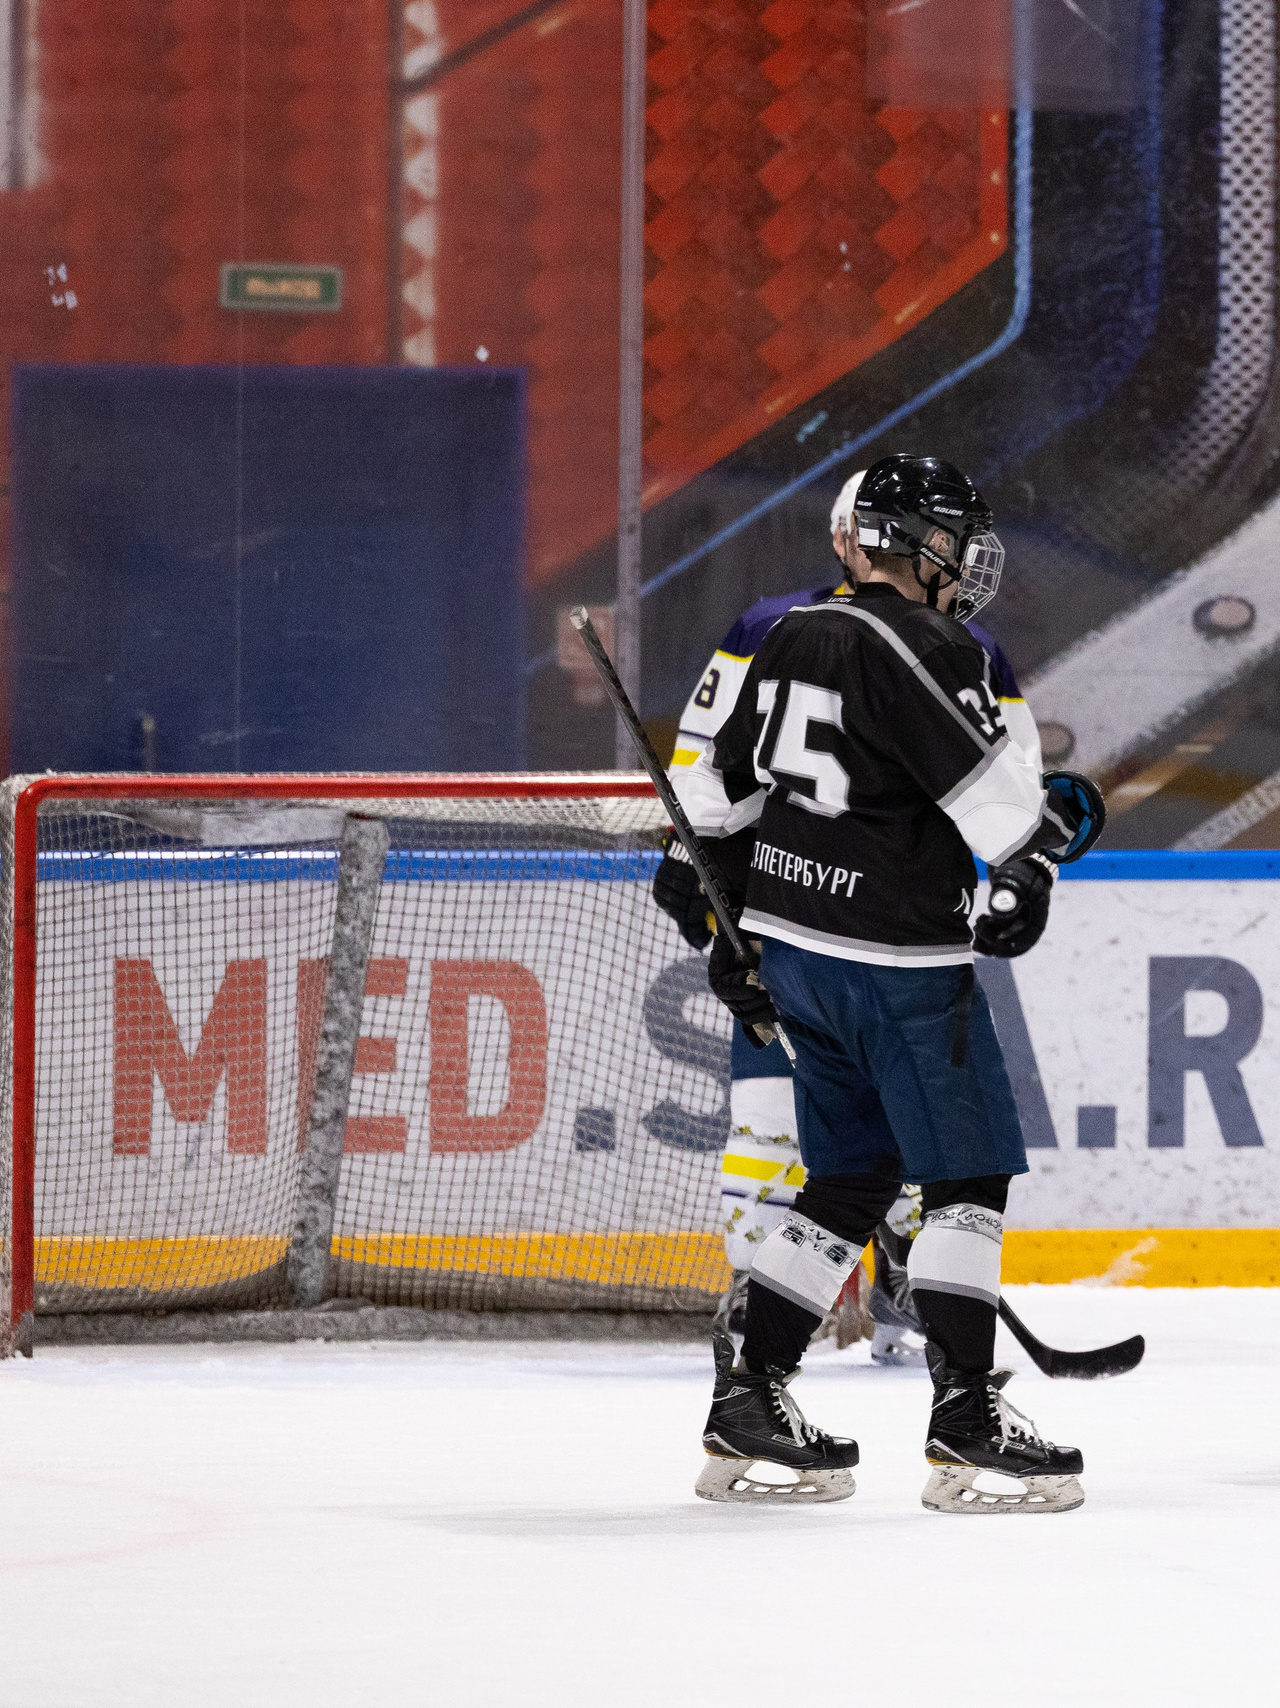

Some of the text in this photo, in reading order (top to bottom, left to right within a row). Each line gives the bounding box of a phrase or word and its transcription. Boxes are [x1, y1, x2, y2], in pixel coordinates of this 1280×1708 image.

[933, 506, 964, 517] BAUER
[920, 547, 946, 567] BAUER
[694, 668, 721, 710] 8
